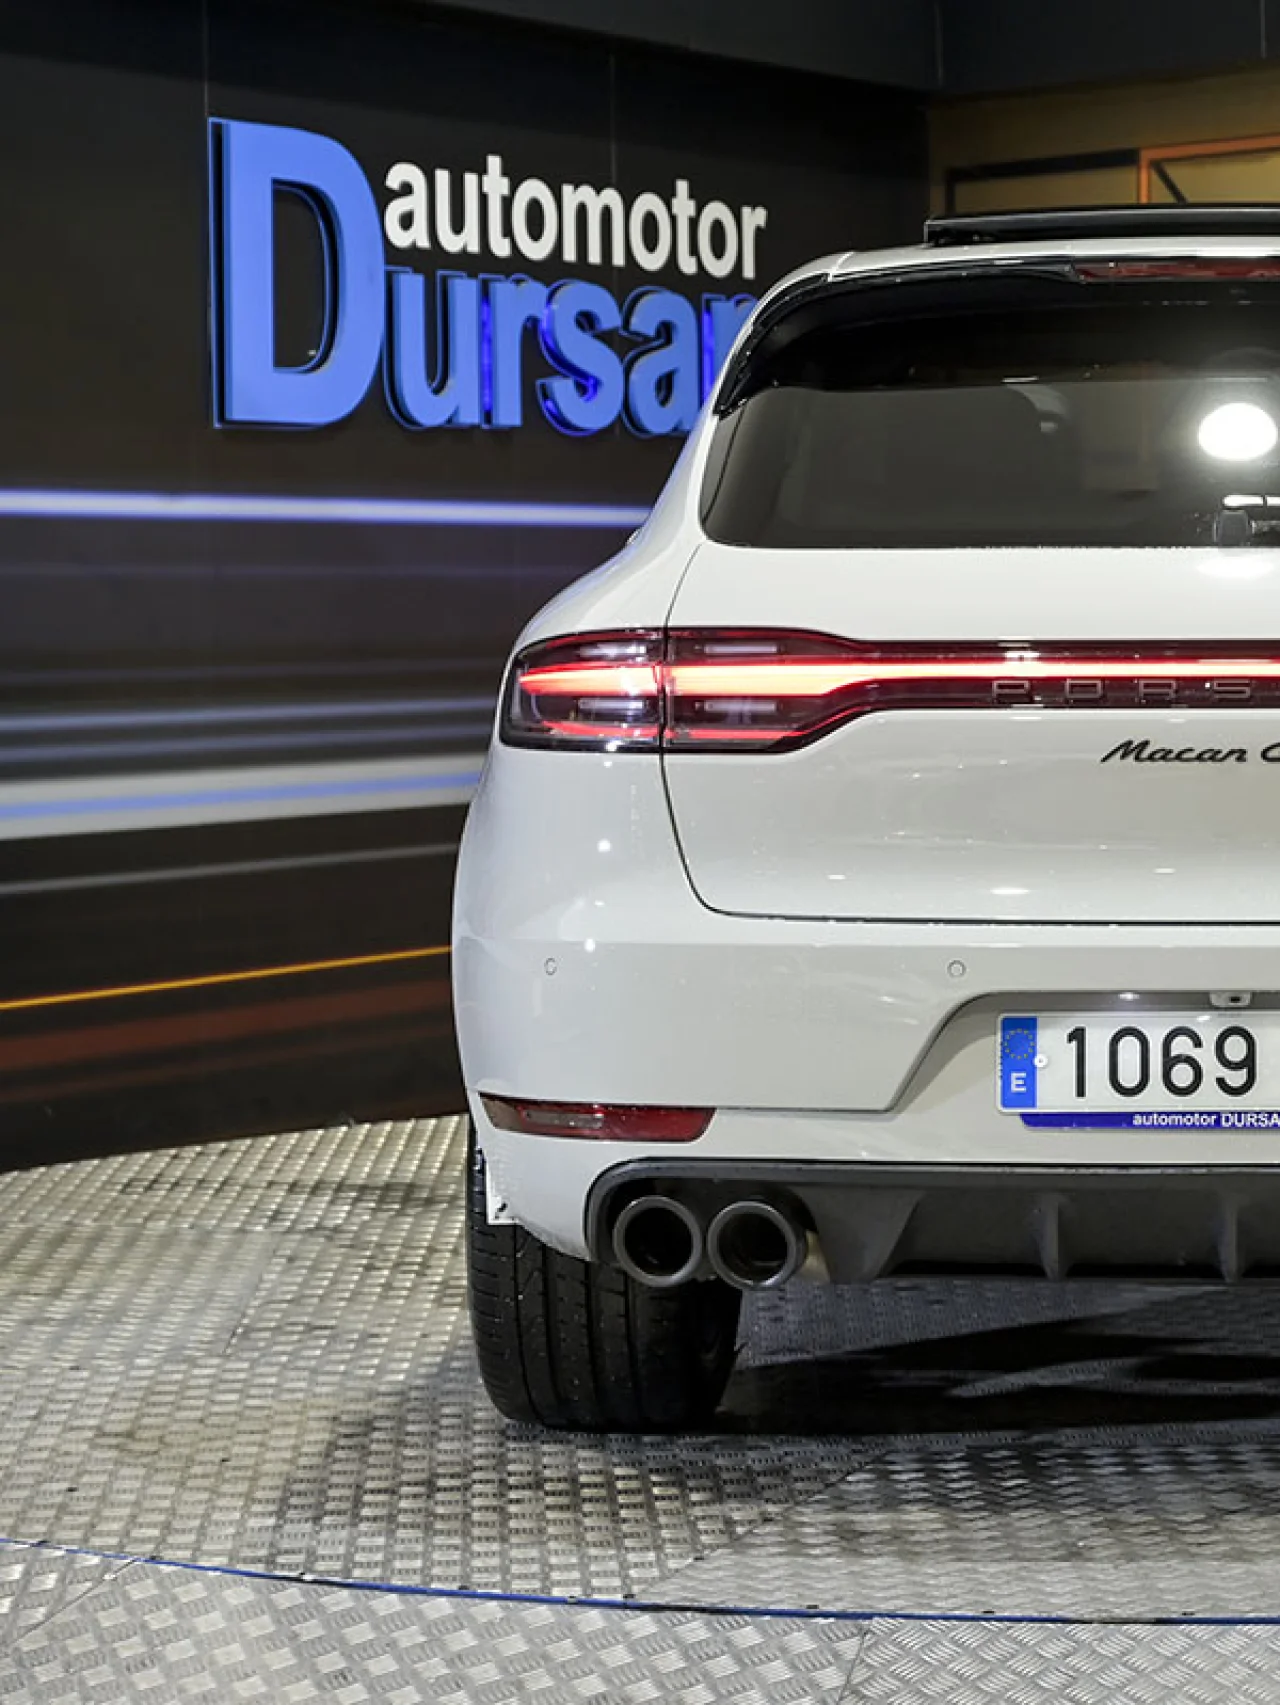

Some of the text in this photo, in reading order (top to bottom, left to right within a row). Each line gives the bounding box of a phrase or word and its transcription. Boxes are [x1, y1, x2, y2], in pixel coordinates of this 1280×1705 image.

[384, 154, 768, 279] automotor
[1100, 739, 1248, 763] Macan
[1066, 1025, 1257, 1098] 1069
[1010, 1071, 1027, 1093] E
[1132, 1112, 1217, 1126] automotor
